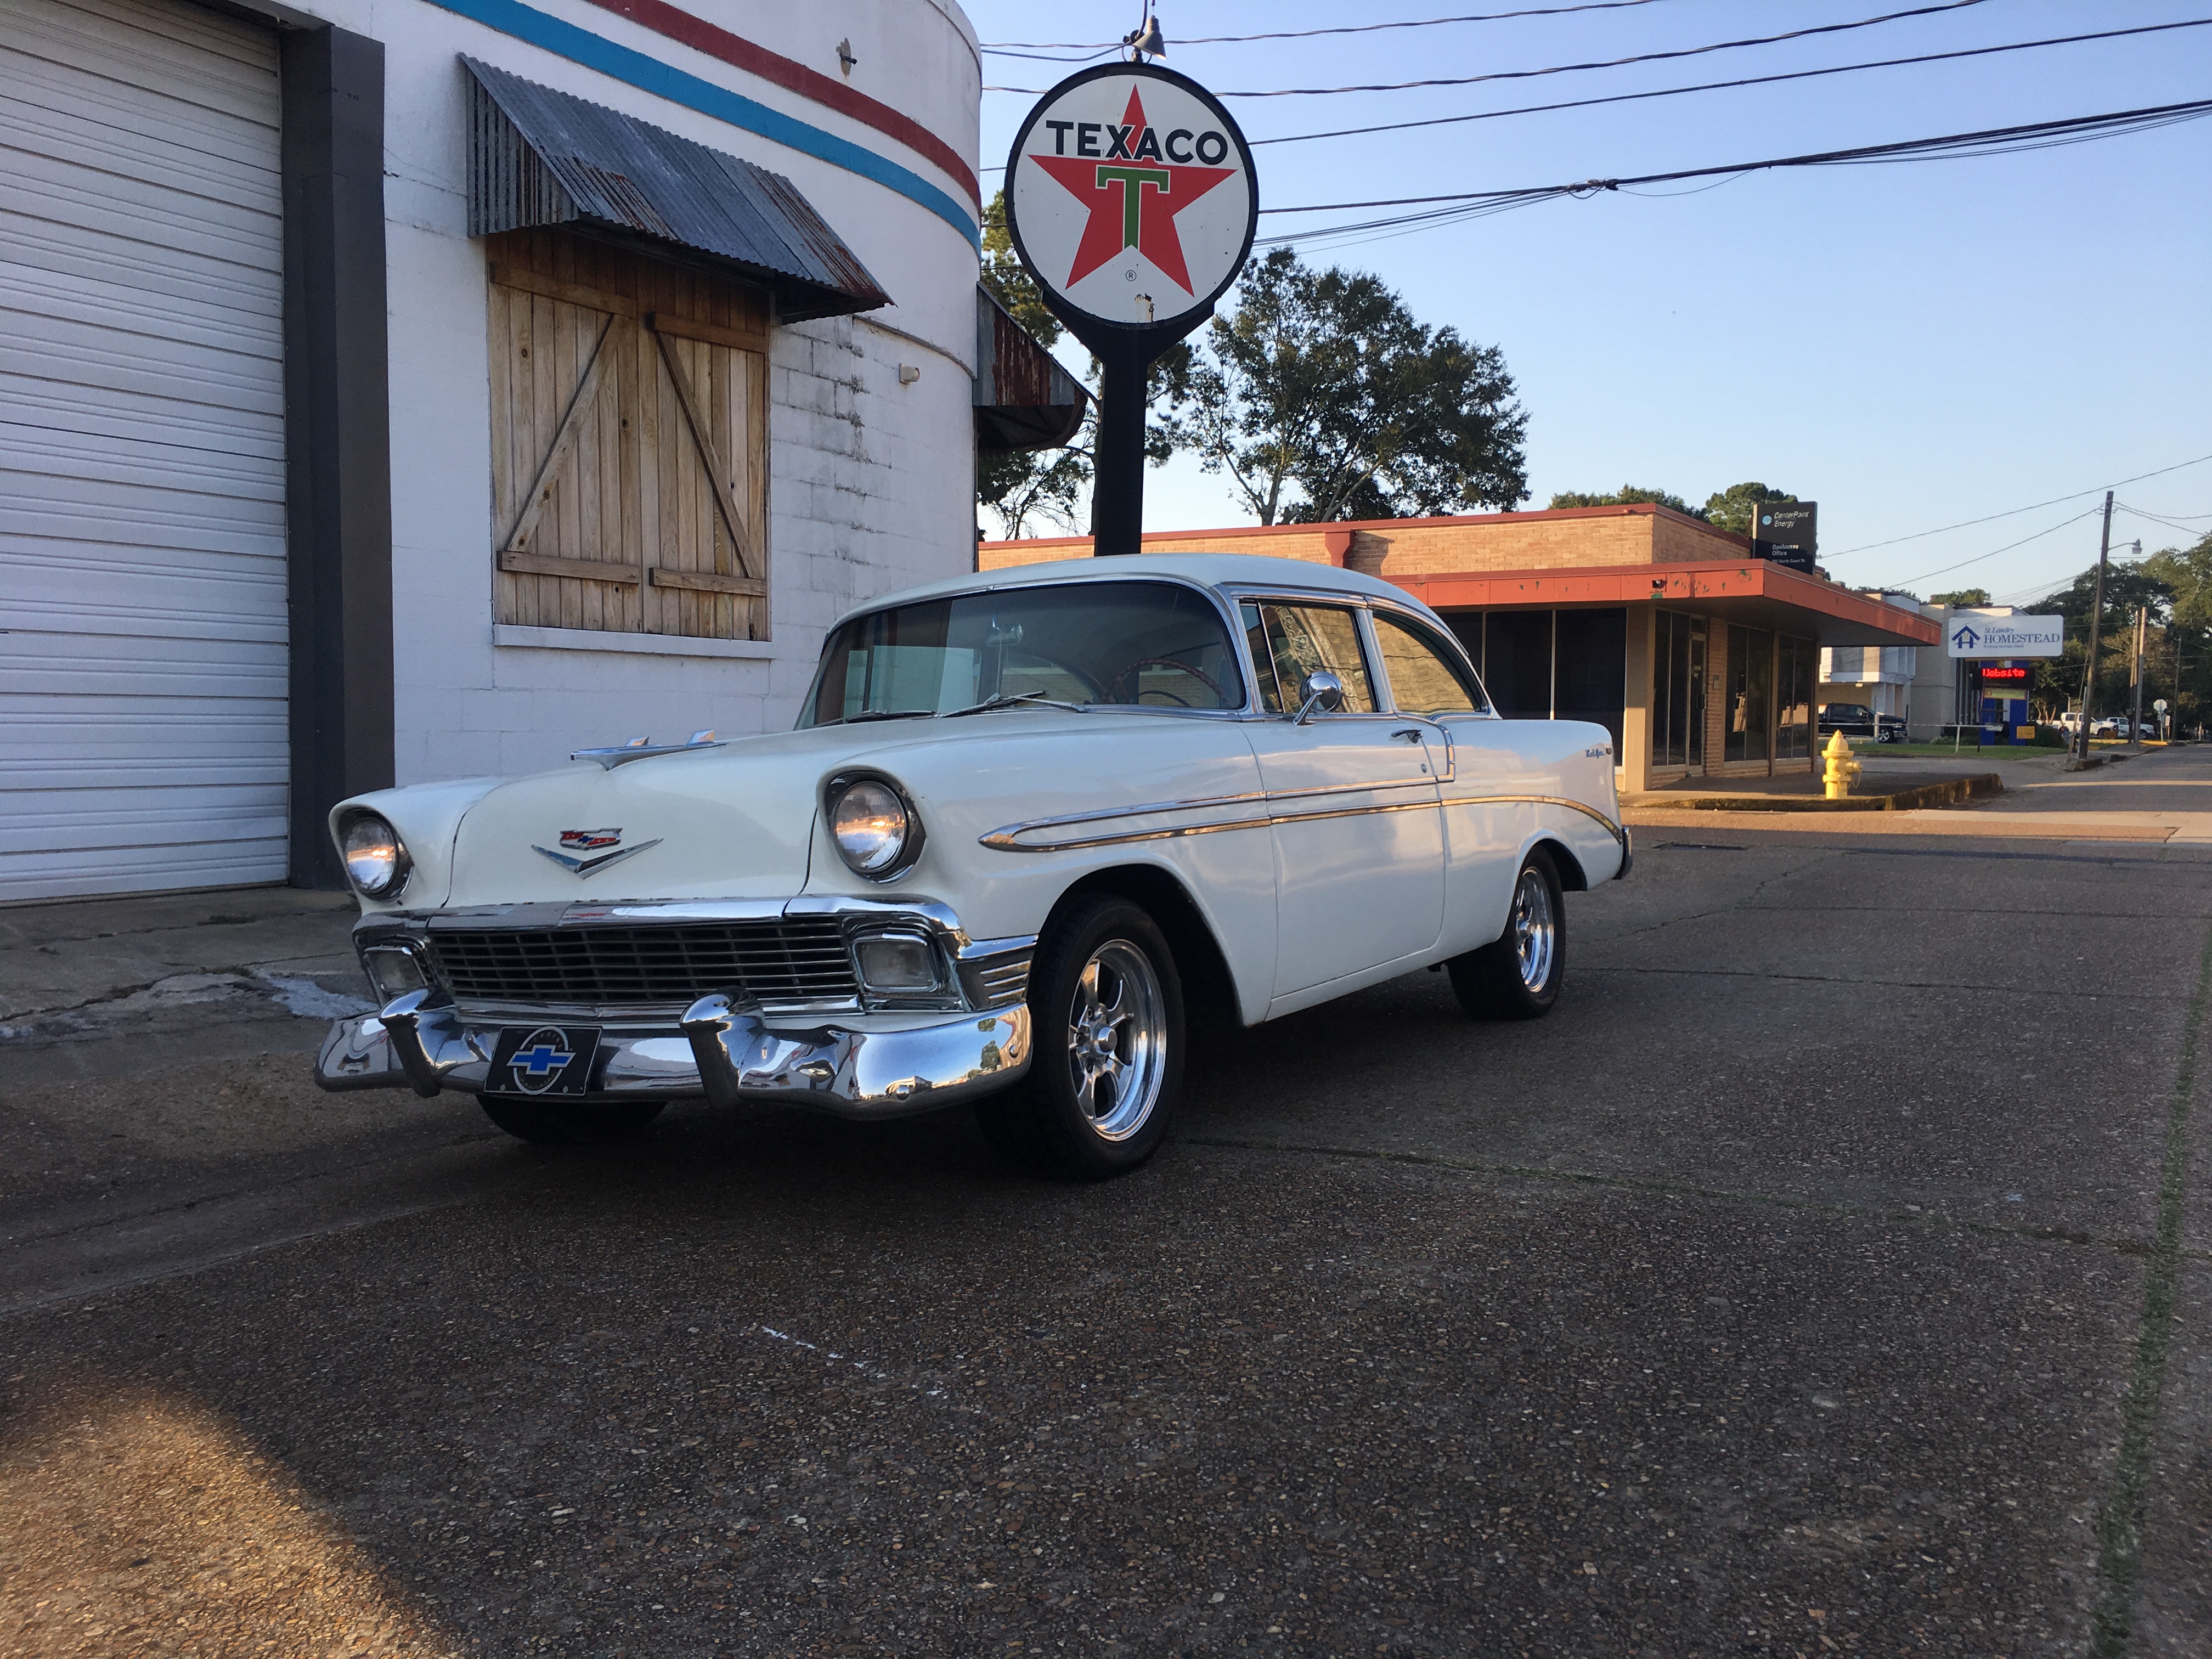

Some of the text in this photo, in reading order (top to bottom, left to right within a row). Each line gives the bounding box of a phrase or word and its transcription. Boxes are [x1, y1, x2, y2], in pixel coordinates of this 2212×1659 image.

[1046, 120, 1229, 166] TEXACO
[1096, 164, 1171, 250] T
[1984, 634, 2060, 643] HOMESTEAD
